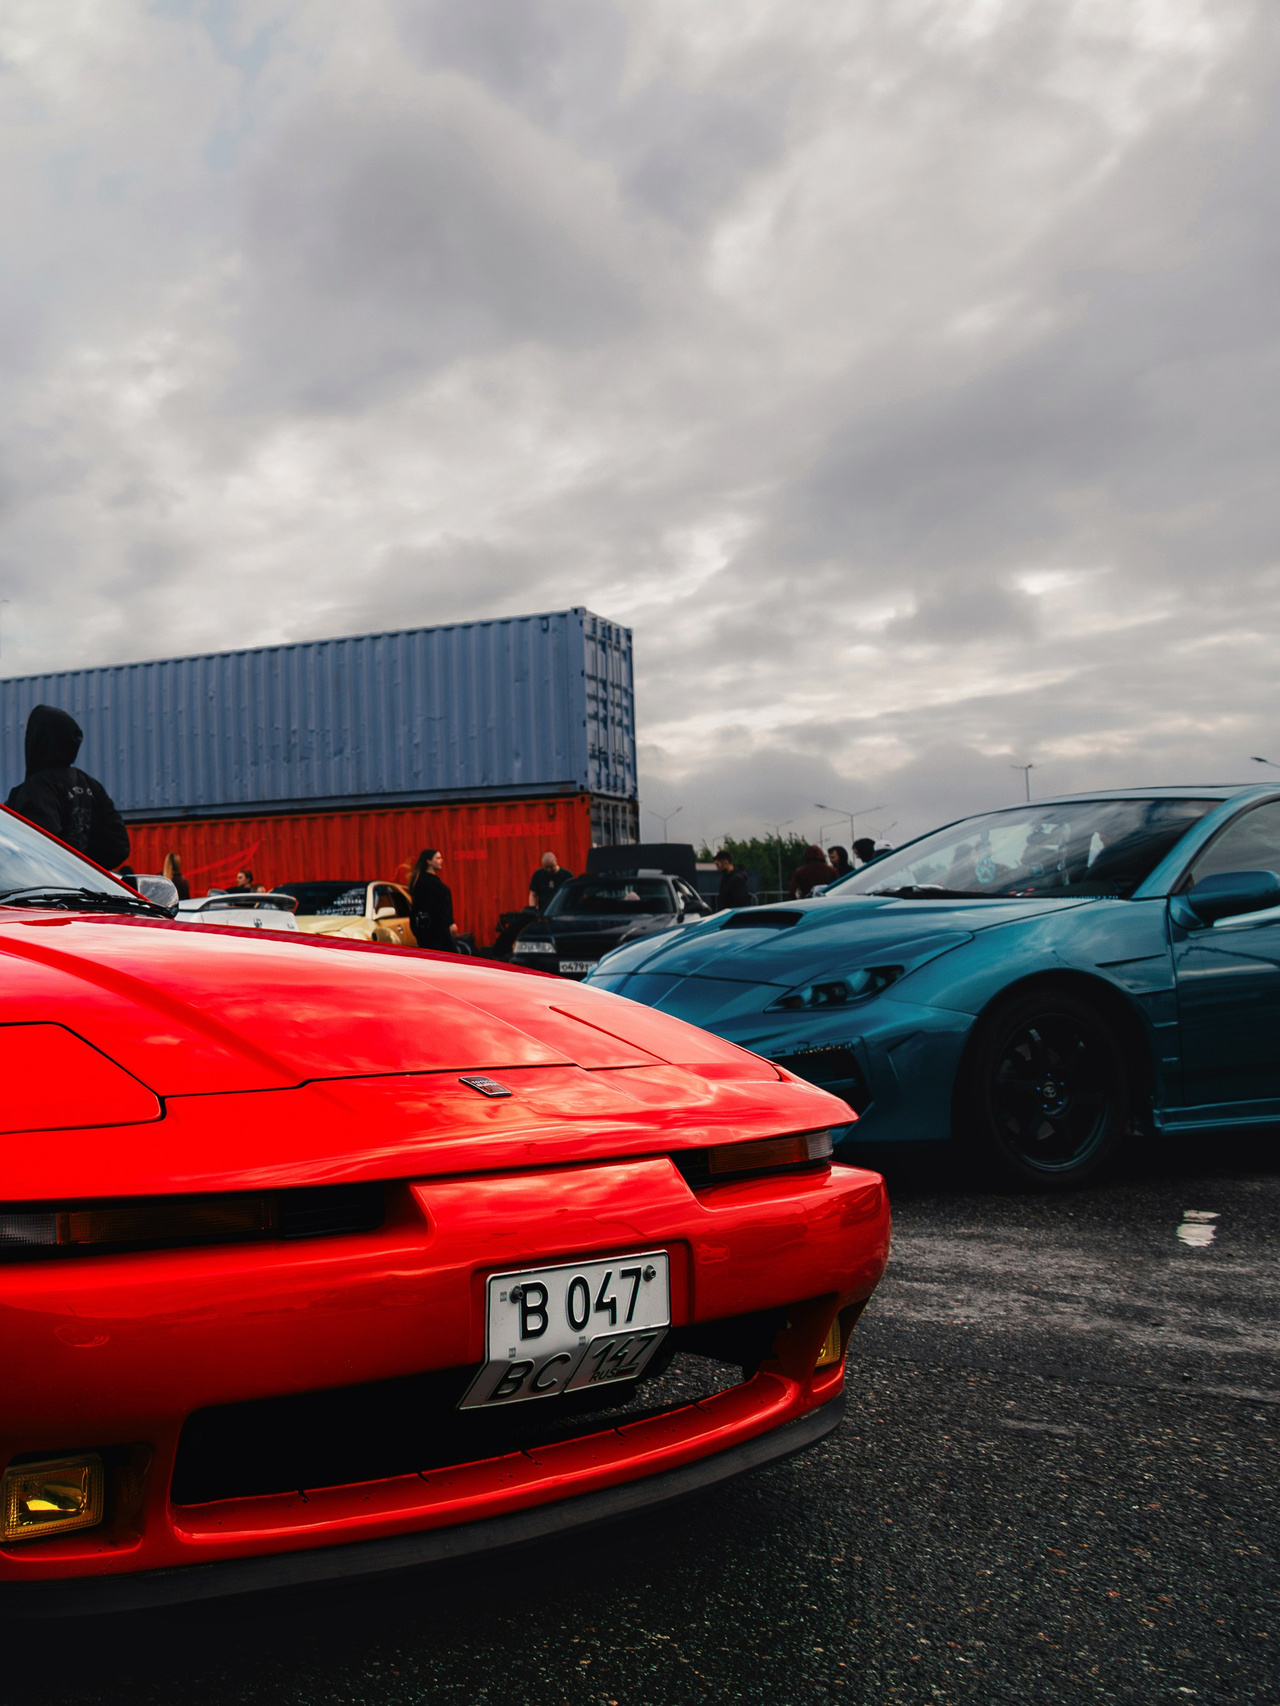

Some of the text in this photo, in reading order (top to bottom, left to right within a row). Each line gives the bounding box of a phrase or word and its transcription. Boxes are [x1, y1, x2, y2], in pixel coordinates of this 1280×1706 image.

[519, 1266, 642, 1341] B 047
[486, 1334, 657, 1400] BC 147
[589, 1369, 616, 1382] RUS
